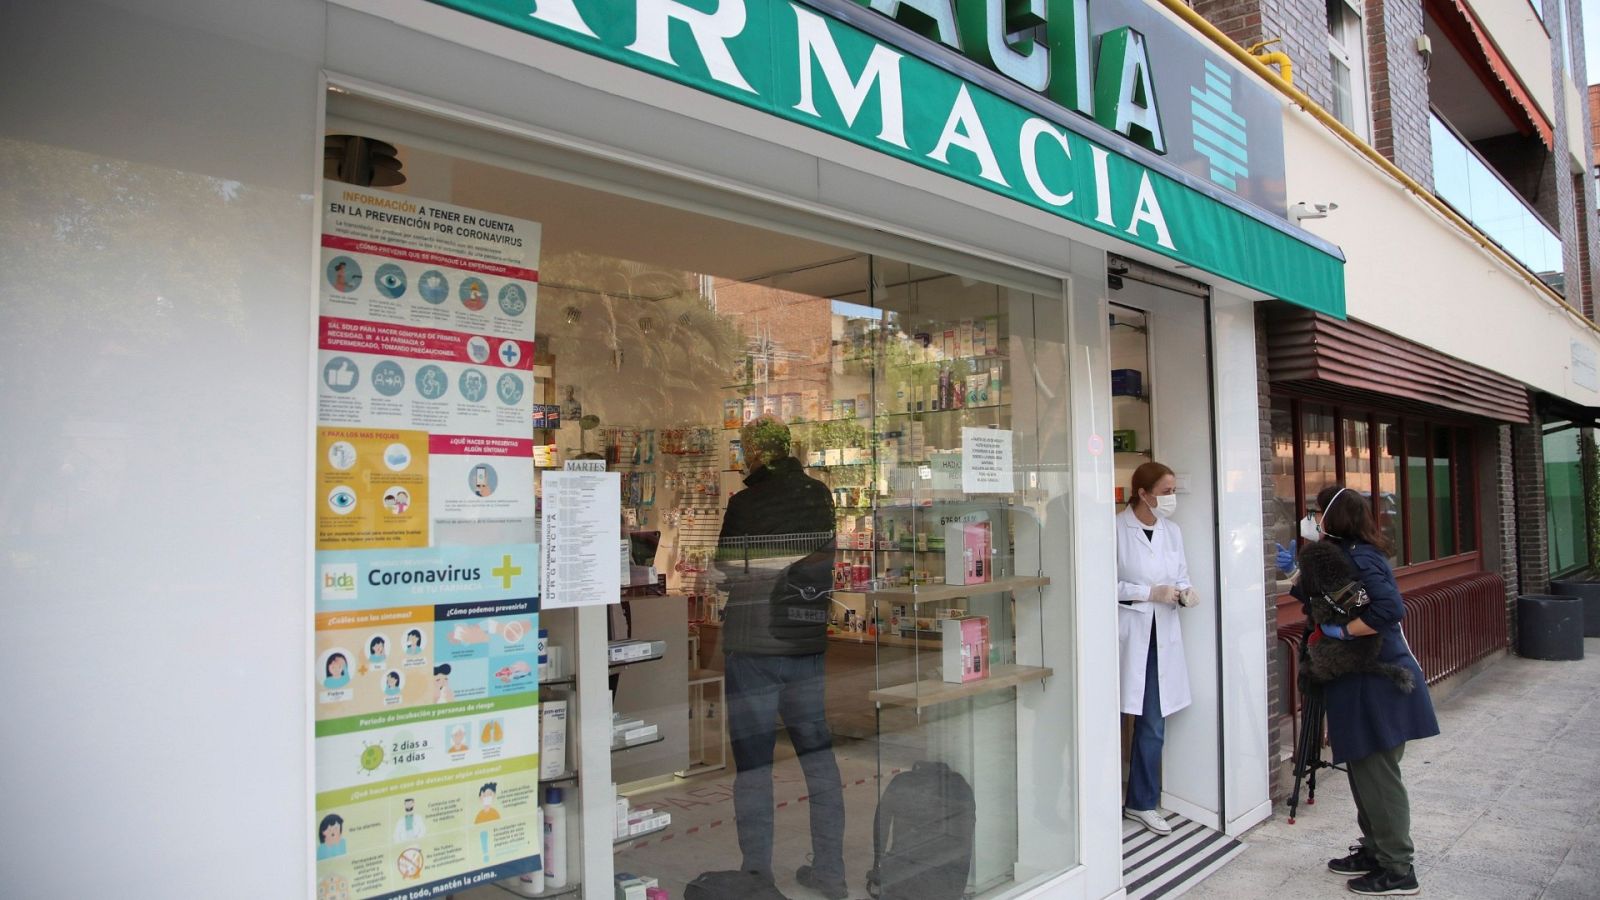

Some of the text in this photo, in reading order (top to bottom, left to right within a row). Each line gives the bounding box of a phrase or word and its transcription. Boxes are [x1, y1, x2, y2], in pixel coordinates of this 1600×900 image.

[529, 0, 1178, 251] RMACIA
[342, 192, 514, 233] INFORMACIÓN A TENER EN CUENTA
[330, 203, 346, 214] EN
[349, 206, 362, 217] LA
[366, 210, 431, 230] PREVENCIÓN
[434, 222, 453, 234] POR
[456, 228, 523, 247] CORONAVIRUS
[377, 327, 397, 335] HACER
[567, 462, 604, 471] MARTES
[325, 572, 354, 588] bida
[368, 565, 480, 586] Coronavirus
[468, 606, 495, 616] podemos
[393, 755, 404, 764] 14
[409, 887, 432, 900] todo,
[433, 876, 462, 892] mantén
[464, 877, 471, 885] la
[473, 871, 497, 884] calma.
